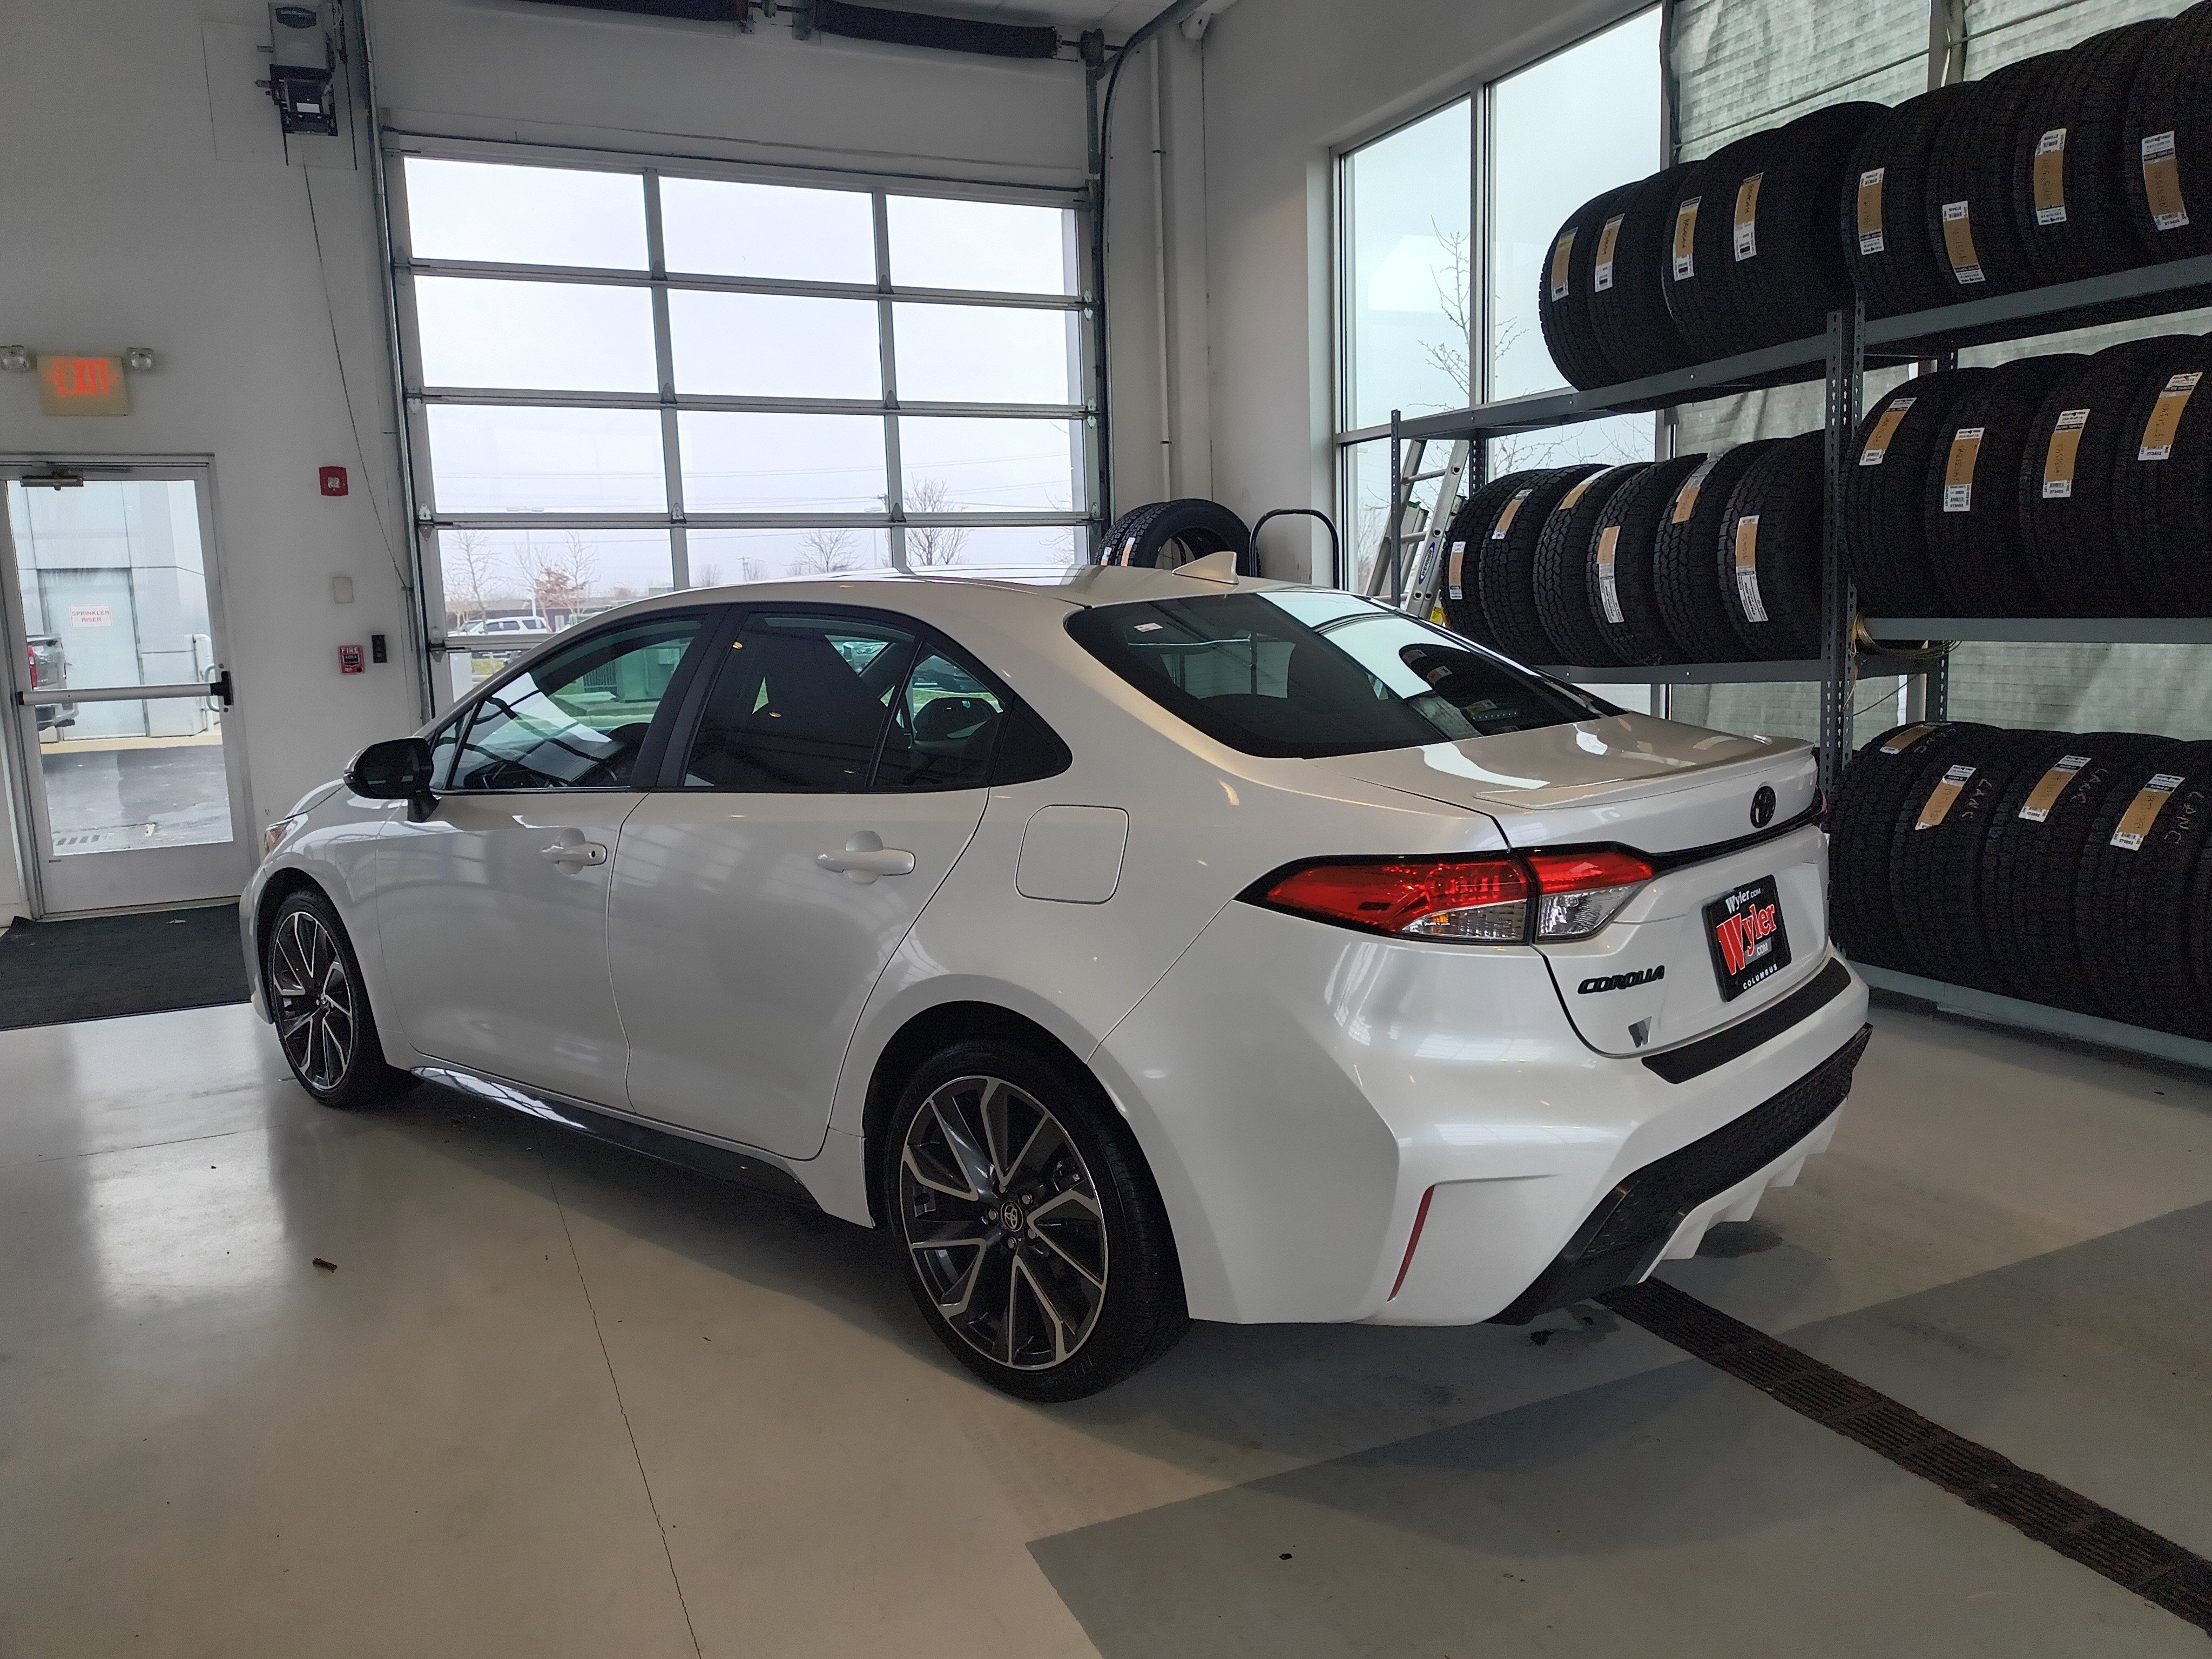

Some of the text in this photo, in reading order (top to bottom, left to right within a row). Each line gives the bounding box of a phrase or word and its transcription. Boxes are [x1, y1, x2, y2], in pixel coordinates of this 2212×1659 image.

[55, 360, 109, 396] EXIT
[1421, 549, 1433, 576] WERNER
[1716, 903, 1777, 976] Wyler
[1577, 965, 1665, 995] COROLLA
[1742, 963, 1778, 990] COLUMBUS
